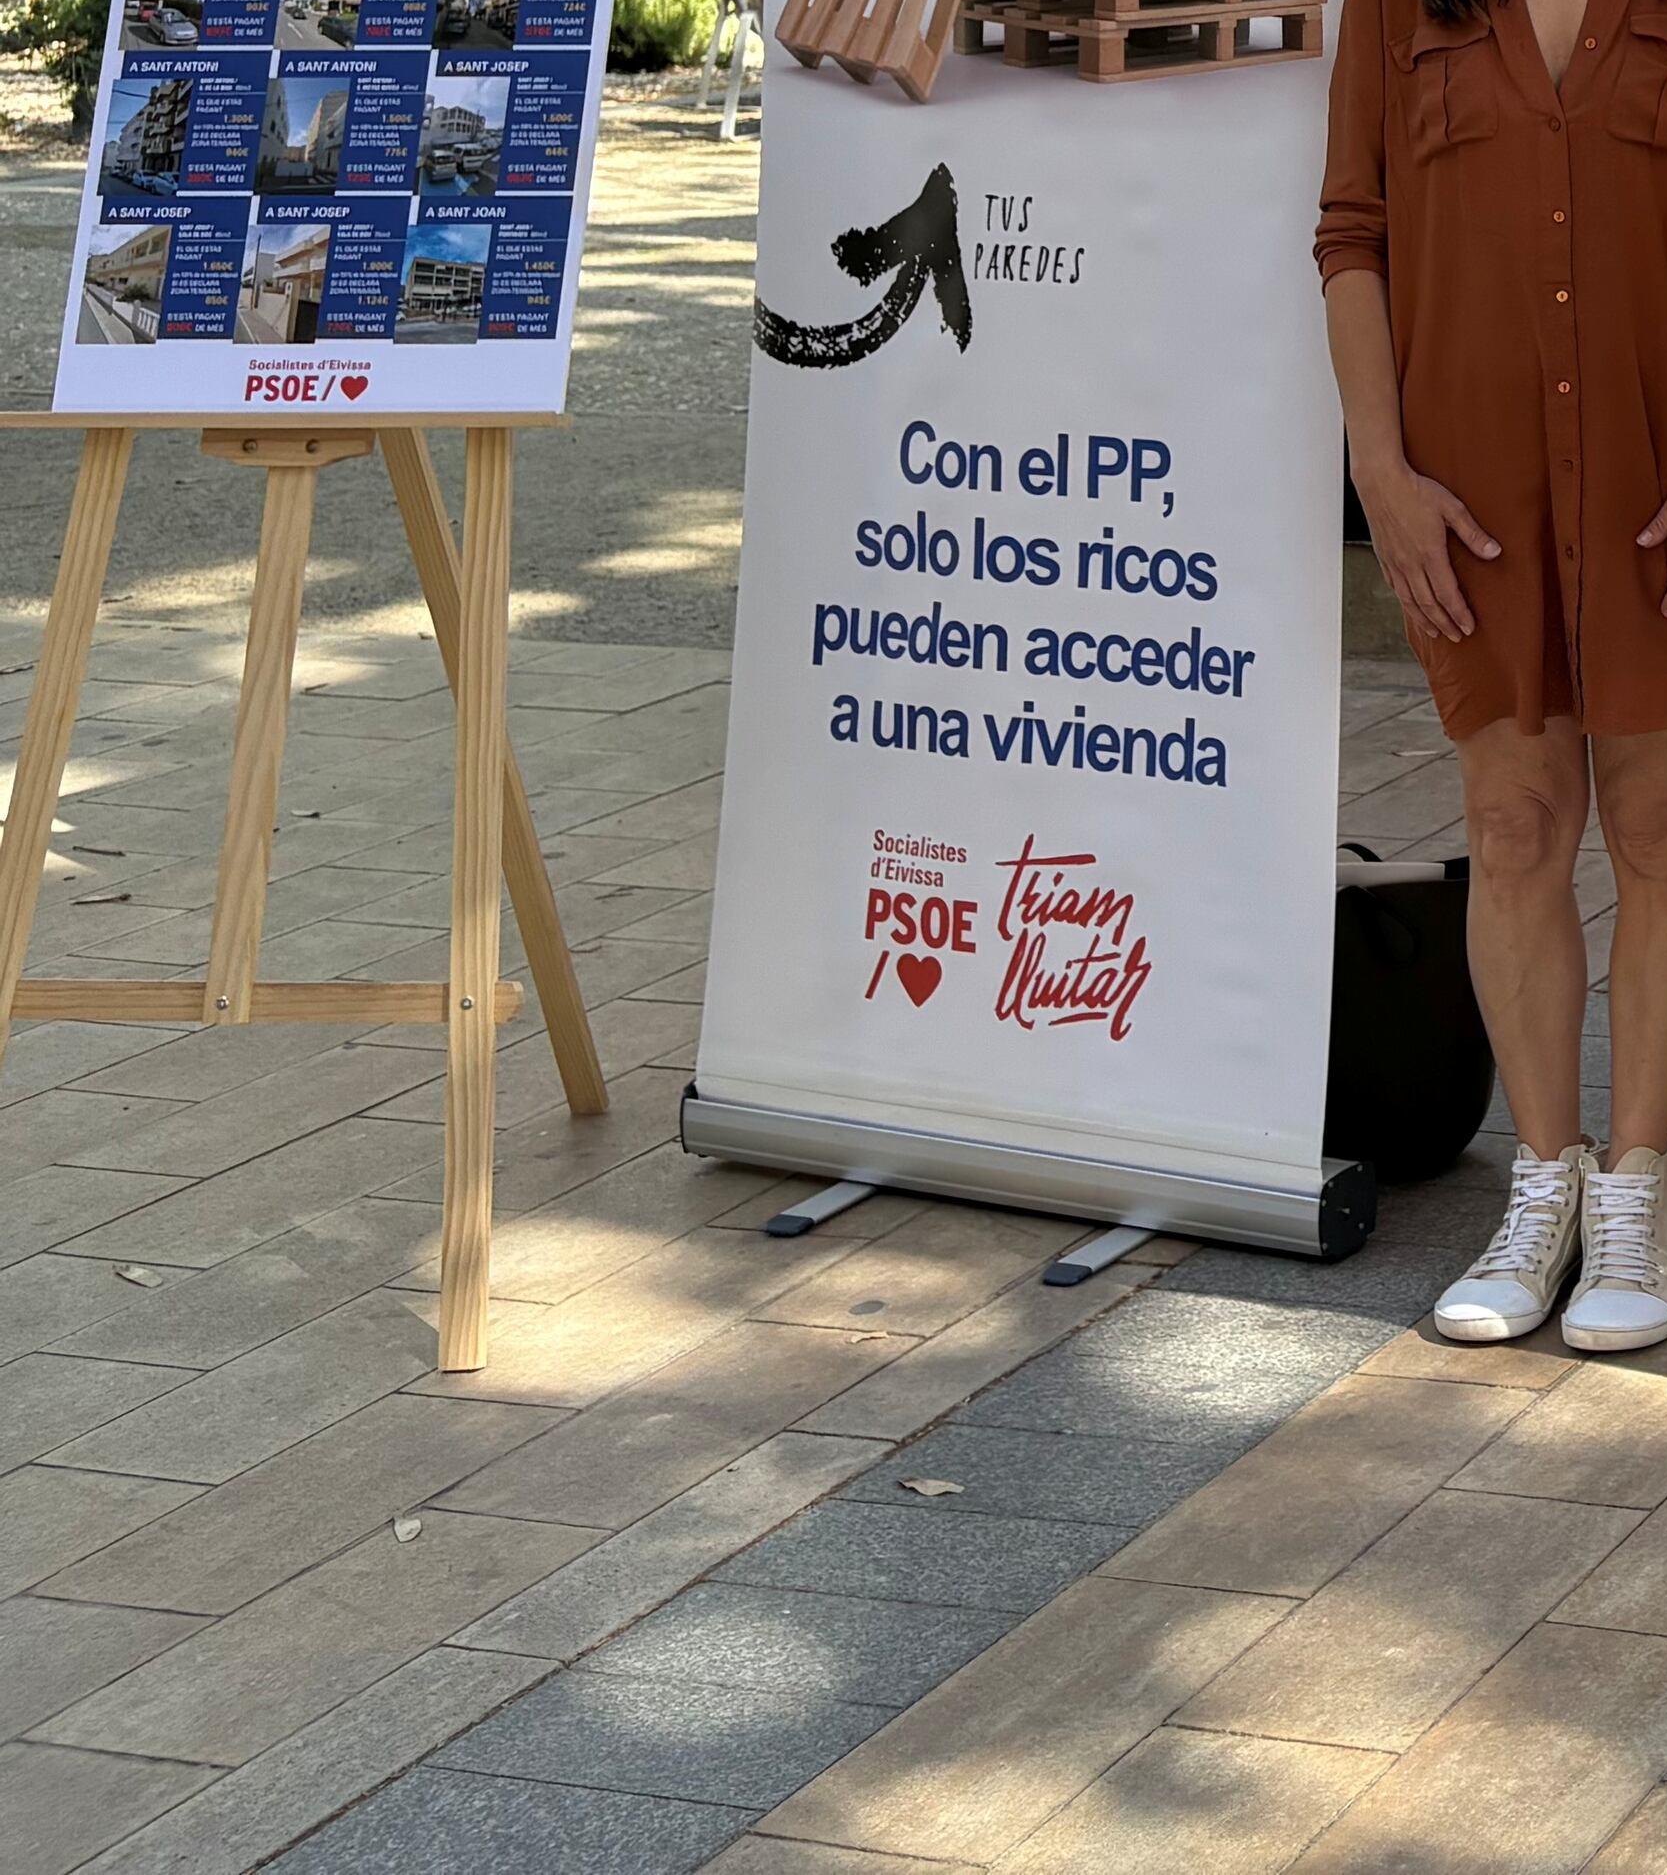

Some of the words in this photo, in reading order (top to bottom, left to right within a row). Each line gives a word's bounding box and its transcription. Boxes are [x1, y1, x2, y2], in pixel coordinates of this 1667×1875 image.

[141, 62, 173, 72] SANT
[297, 62, 330, 72] SANT
[456, 62, 489, 72] SANT
[490, 62, 530, 72] JOSEP
[120, 207, 152, 218] SANT
[153, 207, 192, 218] JOSEP
[277, 207, 310, 218] SANT
[311, 207, 350, 218] JOSEP
[438, 207, 471, 218] SANT
[472, 207, 506, 218] JOAN
[985, 194, 1033, 233] TUS
[974, 242, 1085, 284] PAREDES
[249, 359, 314, 370] Socialistes
[900, 420, 1001, 492] Con
[1018, 433, 1069, 497] el
[1087, 435, 1174, 518] PP,
[856, 510, 960, 577] solo
[973, 517, 1061, 586] los
[1078, 526, 1218, 602] ricos
[812, 601, 1008, 672] pueden
[1024, 627, 1255, 698] acceder
[830, 694, 859, 743] a
[872, 699, 969, 759] una
[984, 701, 1227, 788] vivienda
[873, 829, 967, 864] Socialistes
[870, 857, 944, 888] d'Eivissa
[865, 888, 978, 954] PSOE
